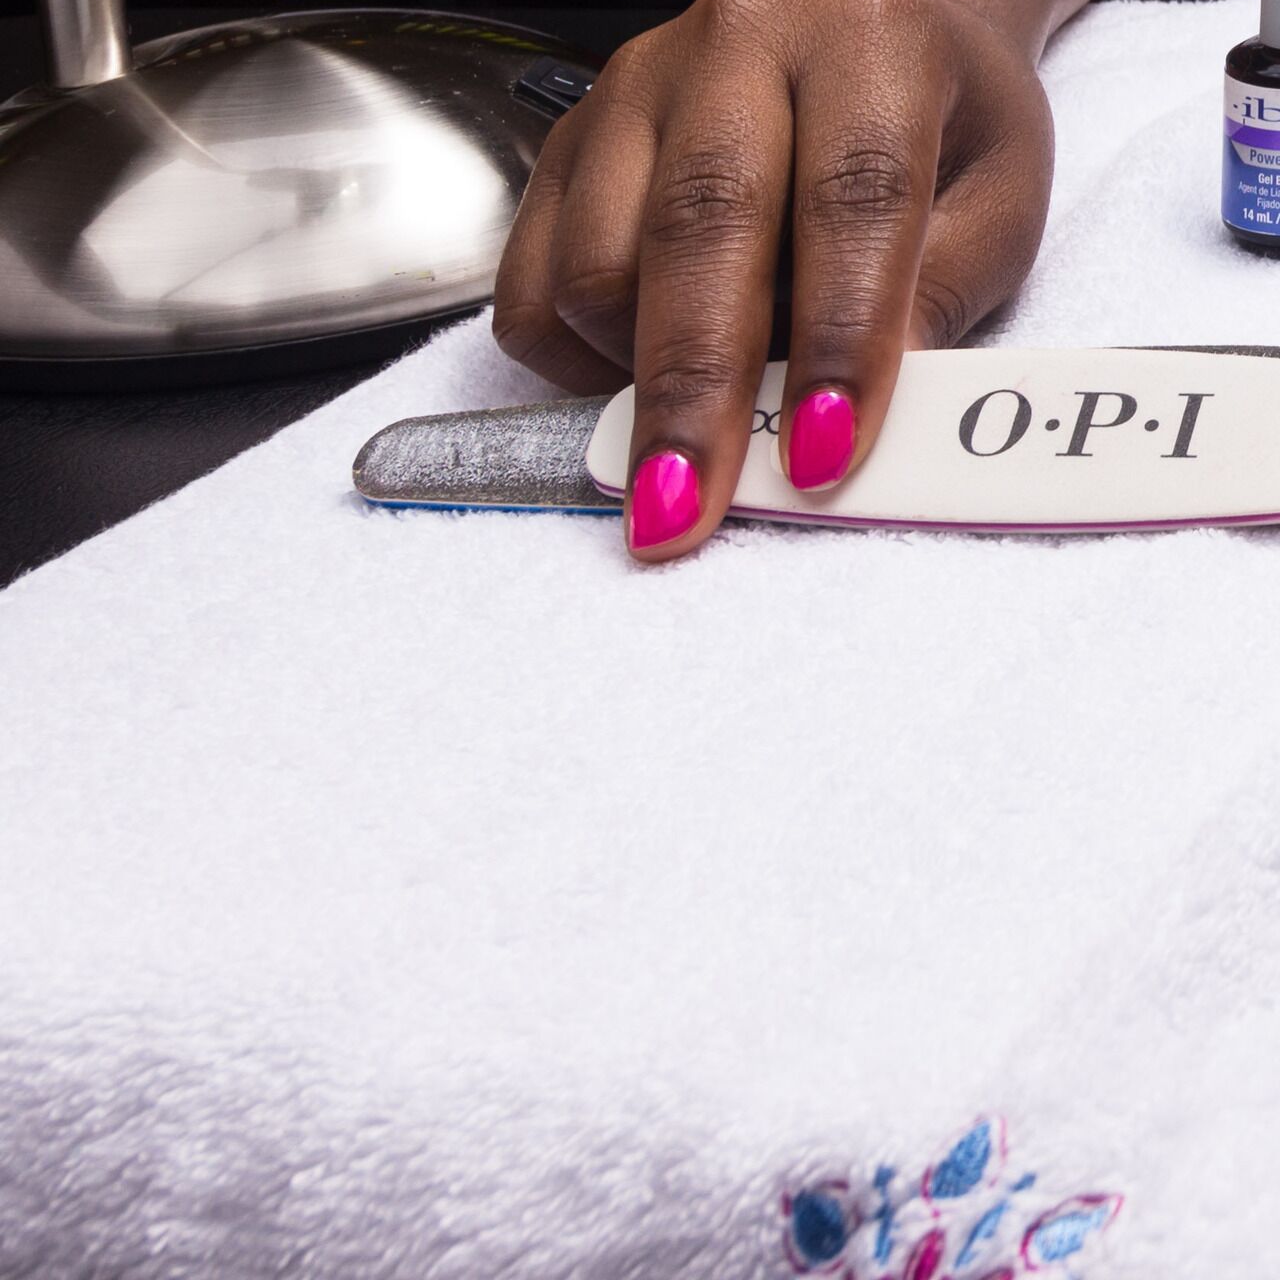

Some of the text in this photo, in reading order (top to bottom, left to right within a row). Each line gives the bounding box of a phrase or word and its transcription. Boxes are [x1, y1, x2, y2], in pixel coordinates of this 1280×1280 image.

[1258, 173, 1273, 184] Gel
[1238, 181, 1257, 195] Agent
[1258, 186, 1268, 196] de
[1243, 208, 1254, 220] 14
[1256, 212, 1273, 224] mL
